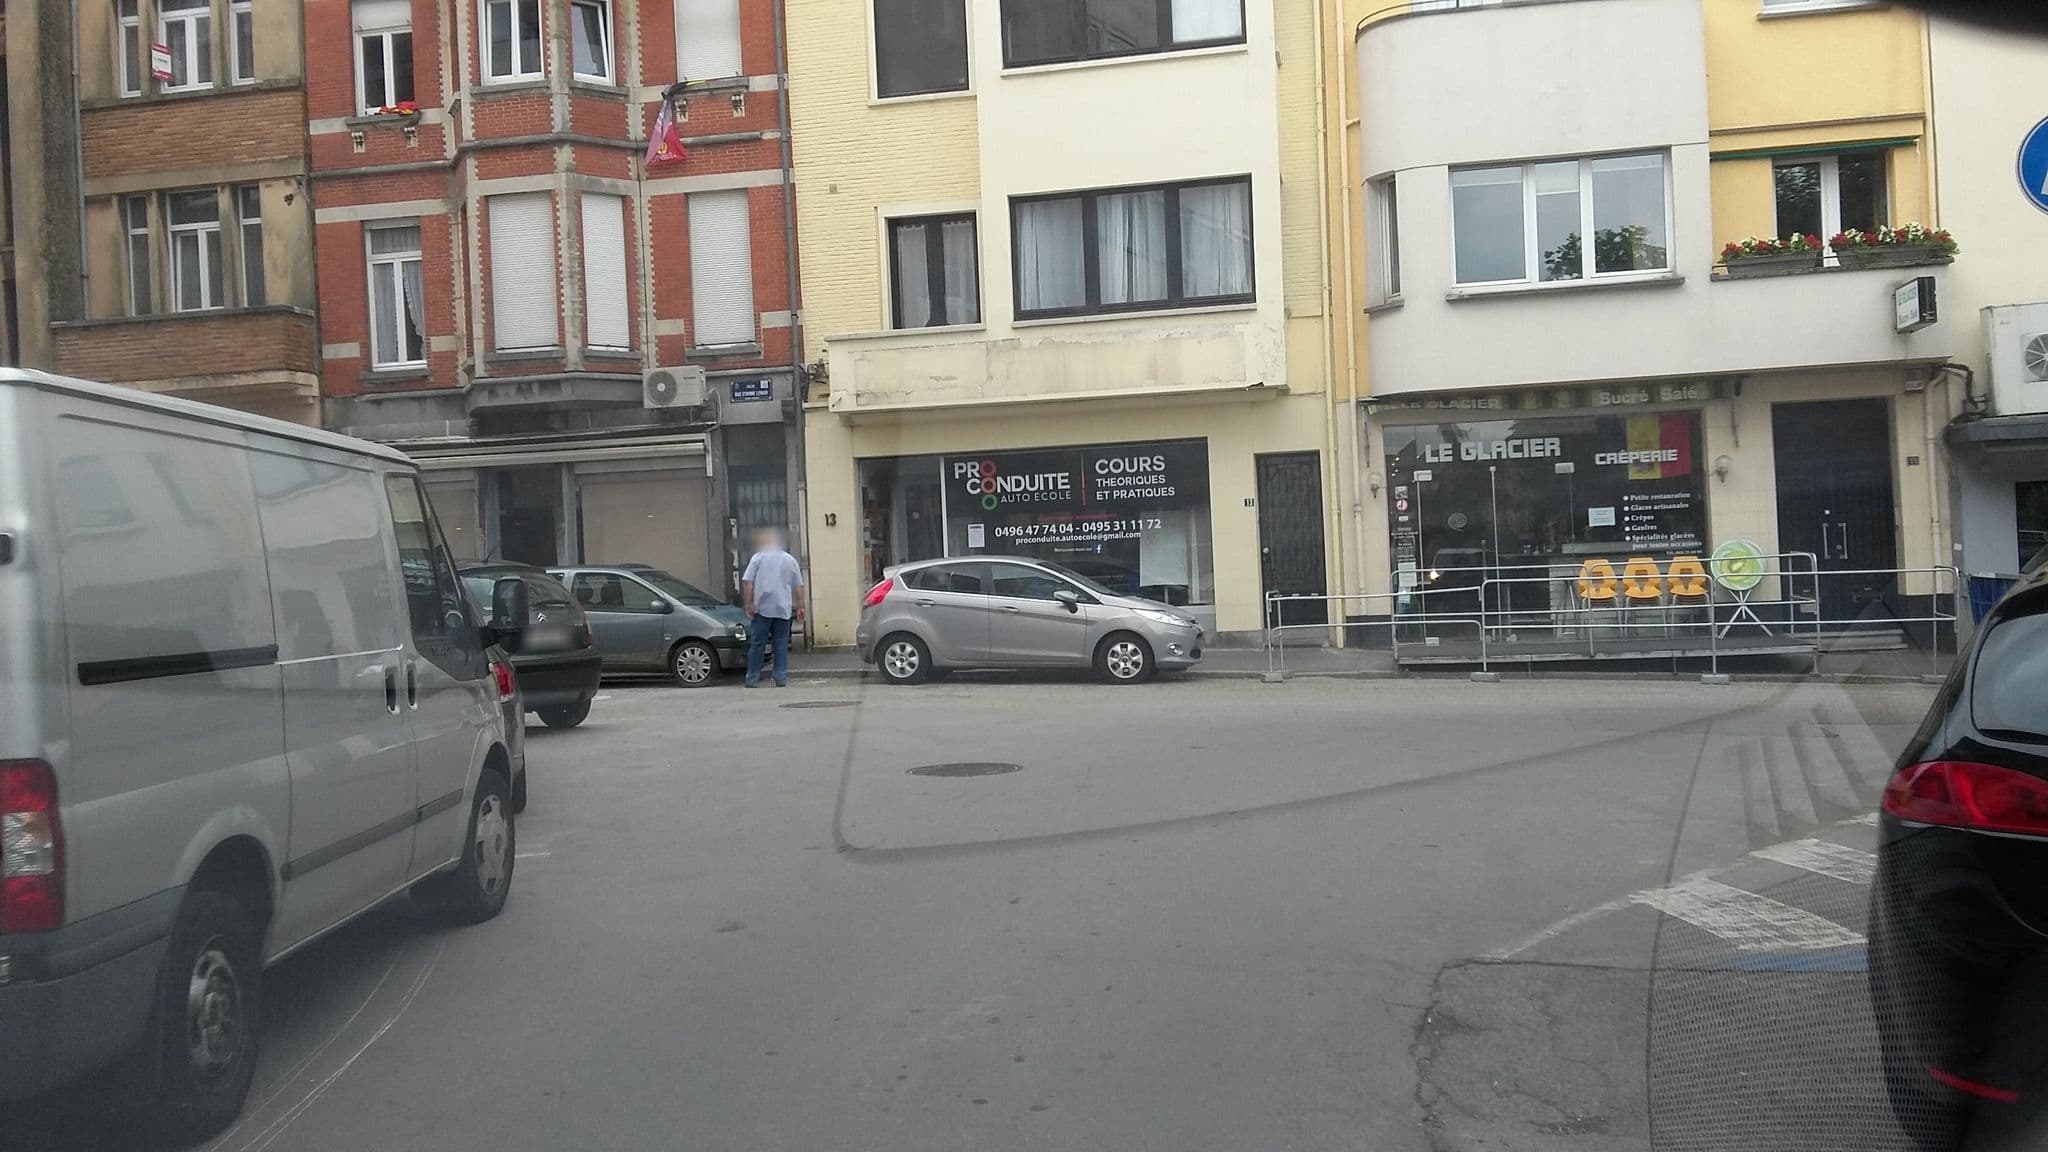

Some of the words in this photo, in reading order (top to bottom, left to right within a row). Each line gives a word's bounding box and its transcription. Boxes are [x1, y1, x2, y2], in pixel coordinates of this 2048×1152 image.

[1600, 389, 1649, 405] Sucré
[1661, 386, 1698, 401] Salé
[1425, 443, 1453, 463] LE
[1460, 437, 1561, 461] GLACIER
[954, 460, 996, 479] PRO
[1095, 455, 1166, 474] COURS
[966, 472, 1071, 495] CONDUITE
[1095, 474, 1166, 487] THEORIQUES
[1000, 493, 1031, 503] AUTO
[1034, 490, 1071, 501] ECOLE
[1096, 490, 1110, 500] ET
[1113, 486, 1176, 500] PRATIQUES
[1651, 492, 1691, 500] restauration
[1653, 502, 1689, 510] artisanales
[824, 513, 837, 527] 13
[994, 525, 1024, 537] 0496
[1025, 524, 1040, 536] 47
[1042, 523, 1057, 535] 74
[1059, 522, 1073, 534] 04
[1082, 520, 1111, 532] 0495
[1113, 520, 1128, 531] 31
[1131, 519, 1143, 531] 11
[1147, 518, 1162, 529] 72
[1015, 531, 1142, 546] proconduite.autoecole@gmail.com
[1632, 533, 1668, 542] Spécialités
[1670, 531, 1695, 541] glacées
